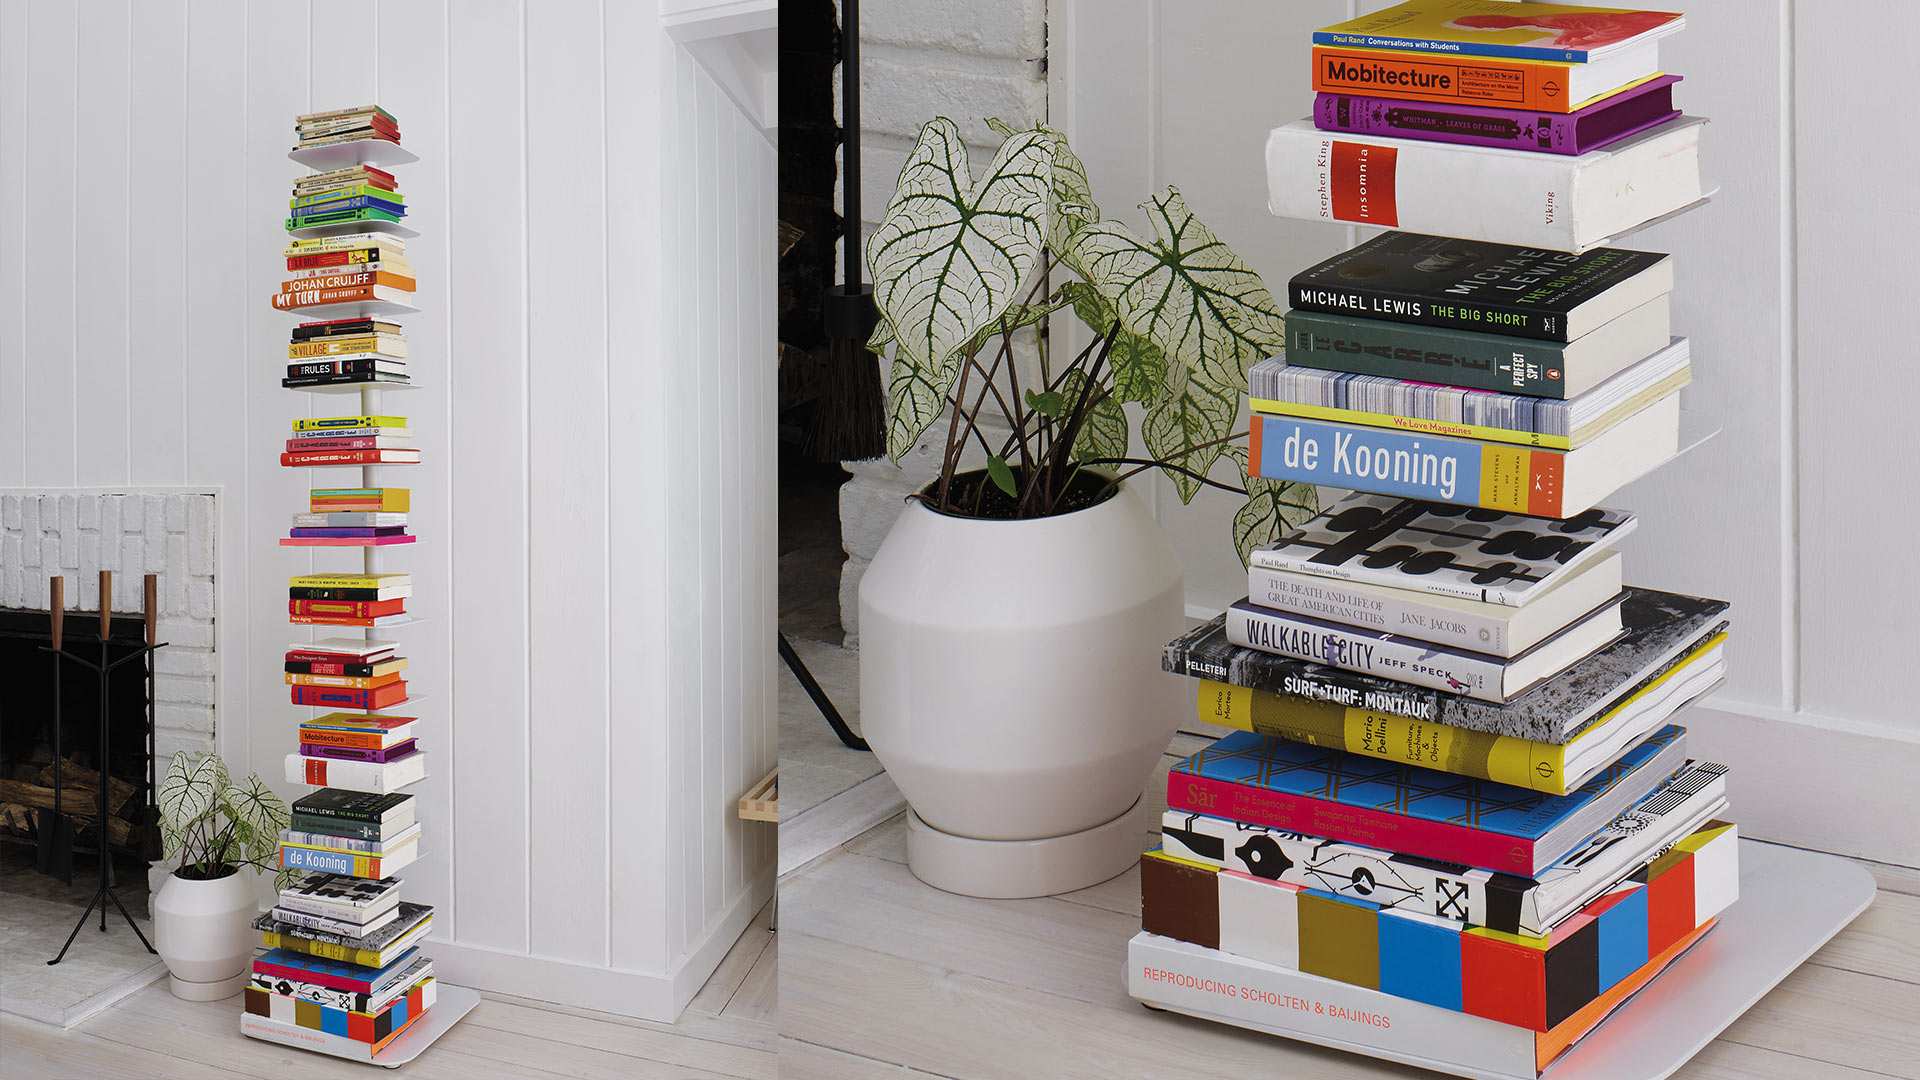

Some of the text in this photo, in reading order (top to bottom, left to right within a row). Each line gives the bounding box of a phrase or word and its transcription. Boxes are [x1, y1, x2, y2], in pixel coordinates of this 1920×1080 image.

[1333, 35, 1460, 51] Paul Rand Conversations with Students
[1328, 61, 1450, 89] Mobitecture
[1403, 115, 1505, 133] WHITMAN LEAVES OF GRASS
[1317, 140, 1329, 218] Stephen King
[1358, 149, 1368, 218] Insomnia
[1545, 191, 1555, 225] Viking
[287, 273, 369, 293] JOHAN CRUIJFF
[1444, 249, 1547, 294] MICHAE
[1495, 254, 1580, 291] LEWIS
[1516, 288, 1554, 303] THE
[1546, 275, 1578, 288] BIG
[1572, 250, 1622, 275] SHORT
[276, 293, 291, 307] MY
[295, 290, 320, 304] TURN
[1300, 289, 1529, 327] MICHAEL LEWIS THE BIG SHORT
[298, 343, 327, 356] VILLAGE
[304, 364, 331, 374] RULES
[1512, 352, 1525, 387] PERFECT
[1526, 362, 1539, 380] SPY
[1393, 416, 1472, 435] We Love Magazines
[1284, 426, 1457, 500] de Kooning
[1261, 557, 1273, 566] Paul
[1274, 560, 1288, 569] Rand
[1300, 564, 1325, 575] Thoughts
[1332, 569, 1351, 578] Design
[1267, 591, 1385, 625] GREAT AMERICAN CITIES
[1268, 578, 1384, 611] THE DEATH AND LIFE OF
[1399, 612, 1467, 635] JANE JACOBS
[1246, 618, 1374, 670] WALKABLE CITY
[1185, 659, 1227, 677] PELLETERI
[1379, 656, 1452, 679] JEFF SPECK
[1215, 691, 1223, 717] Enrico
[1224, 690, 1232, 719] Morteo
[1284, 676, 1430, 719] SURF+TURF: MONTAUK
[304, 732, 345, 743] Mobitecture
[1363, 715, 1374, 751] Mario
[1376, 718, 1388, 754] Bellini
[1406, 723, 1415, 760] Furniture,
[1415, 725, 1423, 761] Machines
[1422, 742, 1430, 750] &
[1430, 732, 1439, 763] Objects
[295, 805, 318, 814] MICHAEL
[1186, 783, 1296, 811] Sār The Essence of
[1232, 805, 1291, 824] Indian Design
[1357, 814, 1398, 831] Tamhane
[1313, 819, 1375, 840] Rashmi Varma
[290, 850, 347, 874] de Kooning
[1143, 967, 1391, 1029] REPRODUCING SCHOLTEN & BAIJINGS
